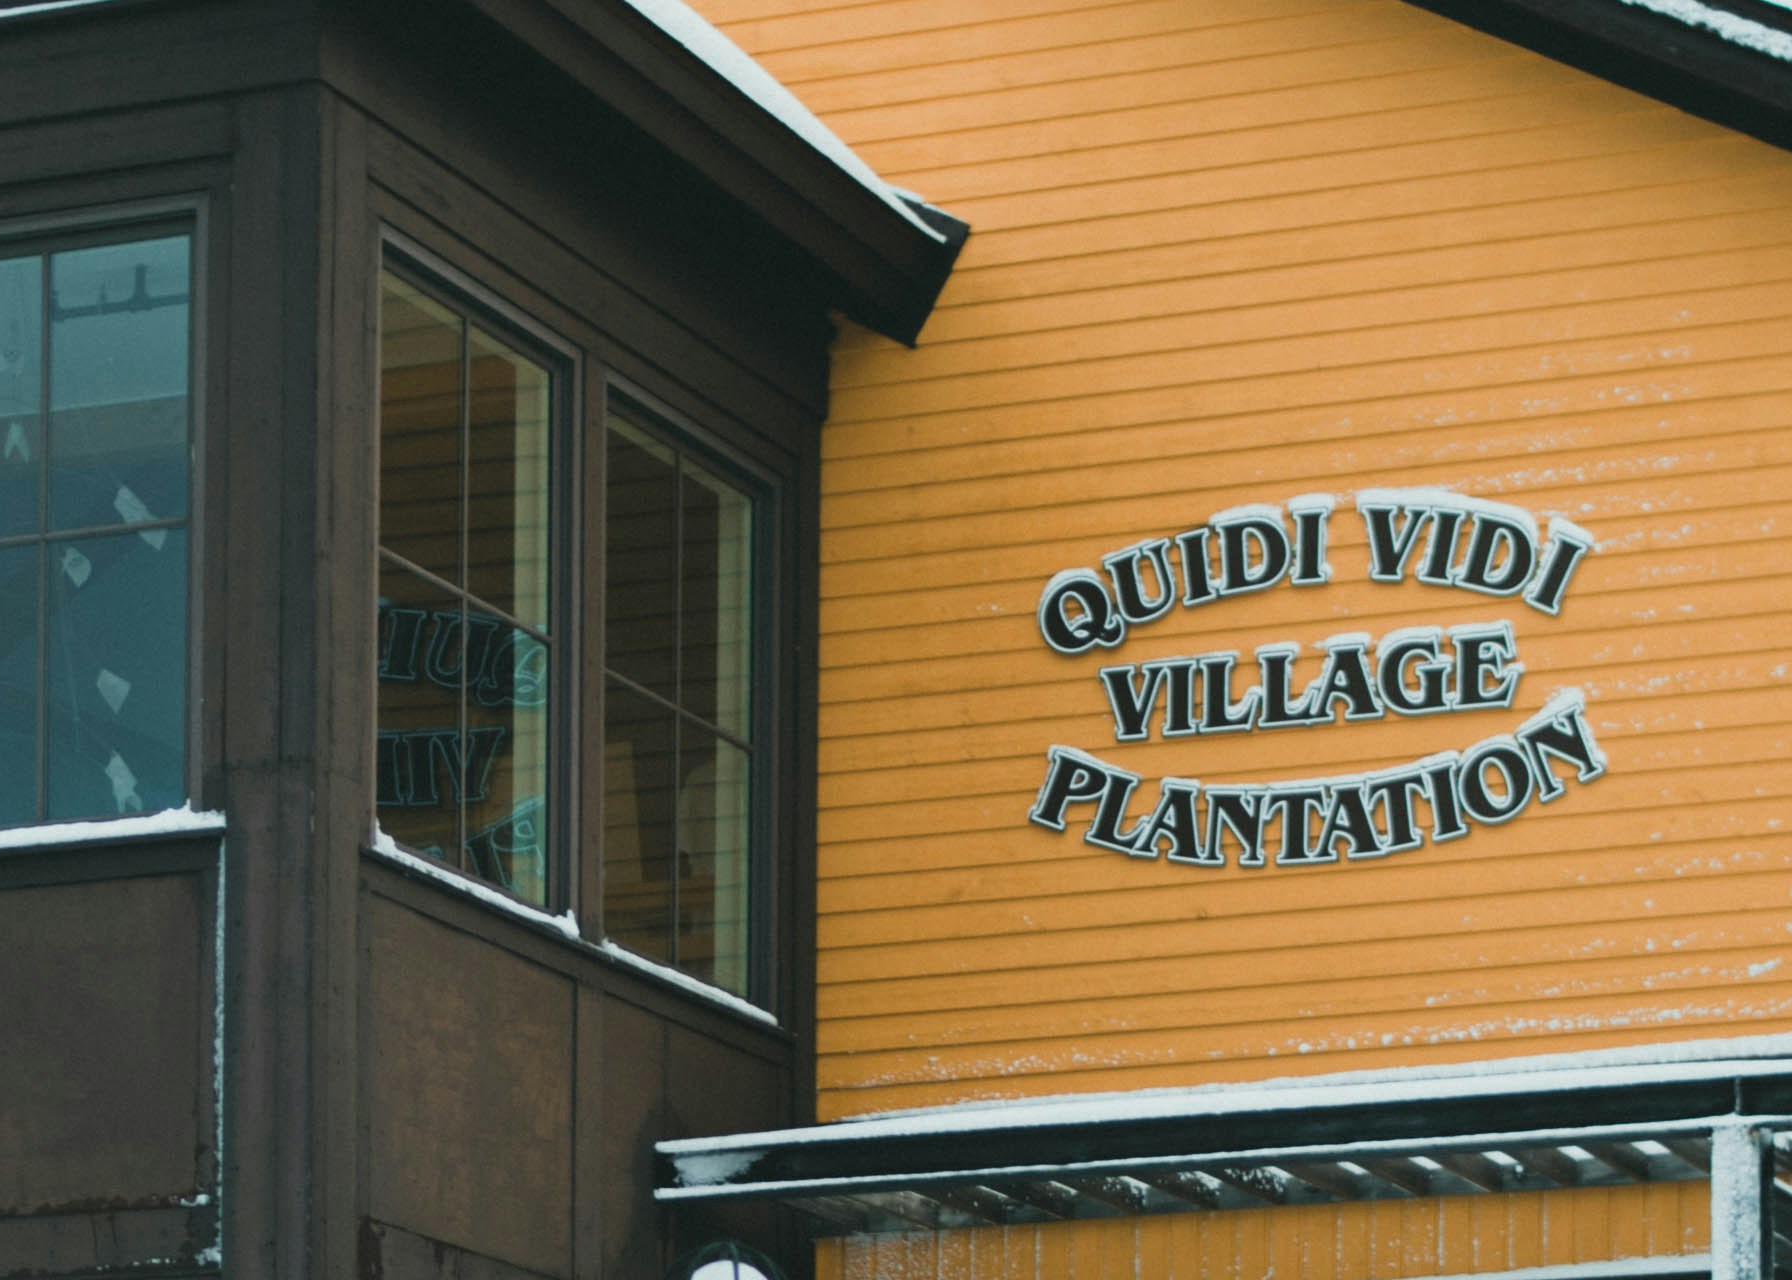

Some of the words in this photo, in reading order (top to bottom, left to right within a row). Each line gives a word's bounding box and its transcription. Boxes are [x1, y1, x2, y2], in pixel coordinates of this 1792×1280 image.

[1039, 503, 1333, 653] QUIDI
[1358, 501, 1589, 615] VIDI
[1100, 625, 1522, 741] VILLAGE
[1029, 696, 1608, 866] PLANTATION
